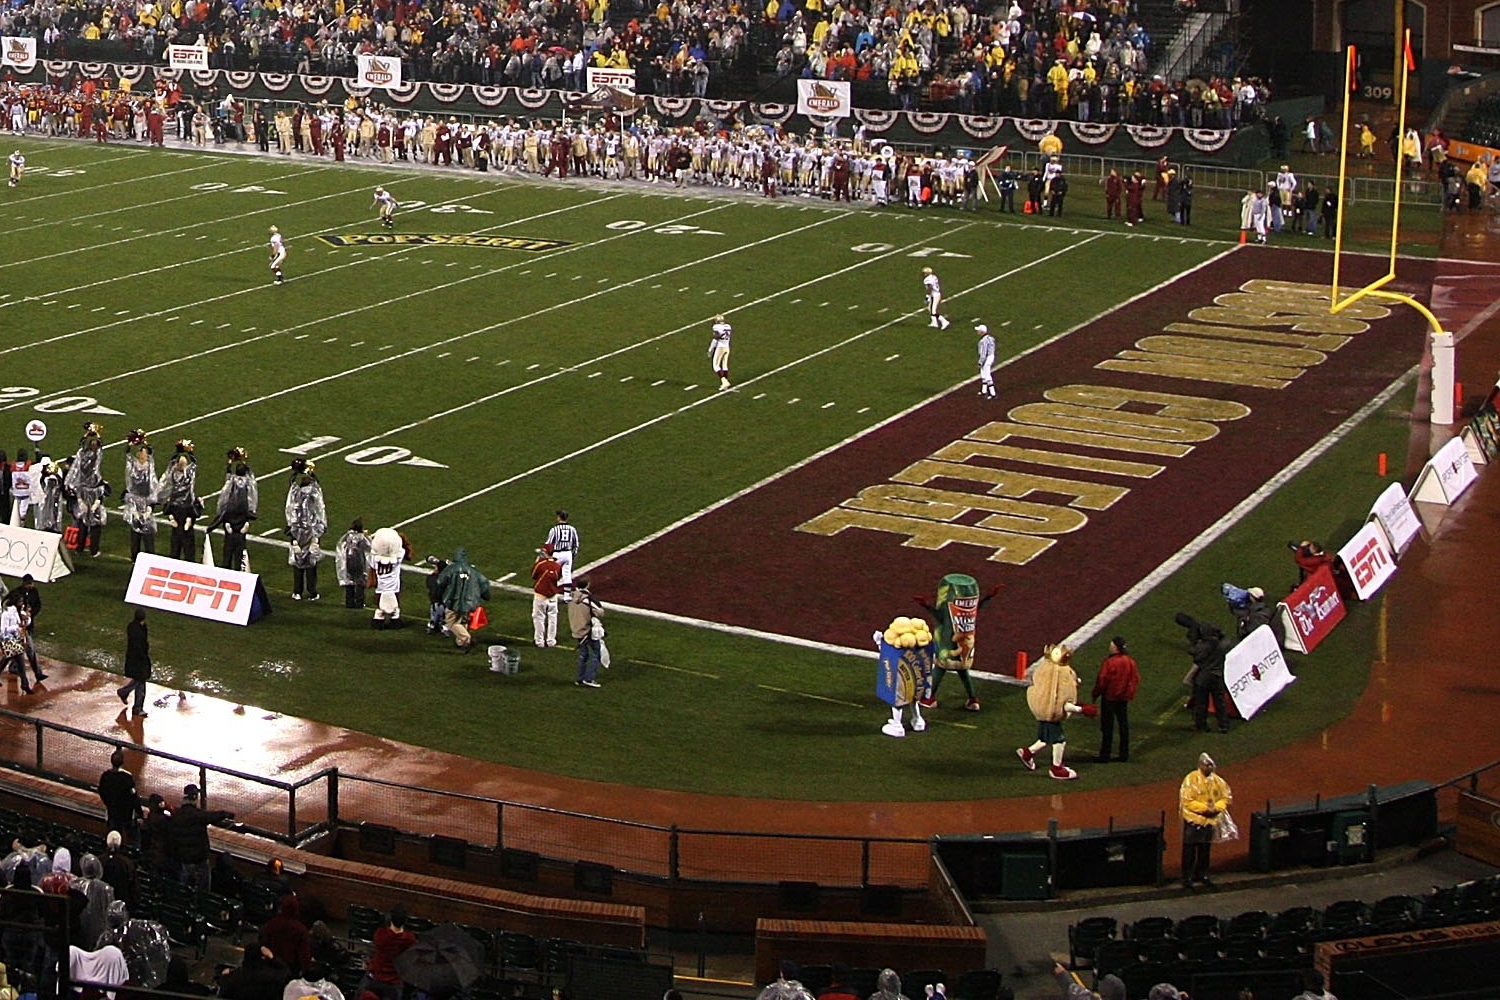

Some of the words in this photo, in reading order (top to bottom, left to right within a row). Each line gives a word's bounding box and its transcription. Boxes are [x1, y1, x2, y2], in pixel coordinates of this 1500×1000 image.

[173, 49, 203, 59] ESPN
[1364, 86, 1392, 98] 309
[808, 99, 839, 107] EMERALD
[280, 435, 412, 465] 10
[1349, 536, 1387, 590] ESPN
[139, 566, 242, 613] ESPN
